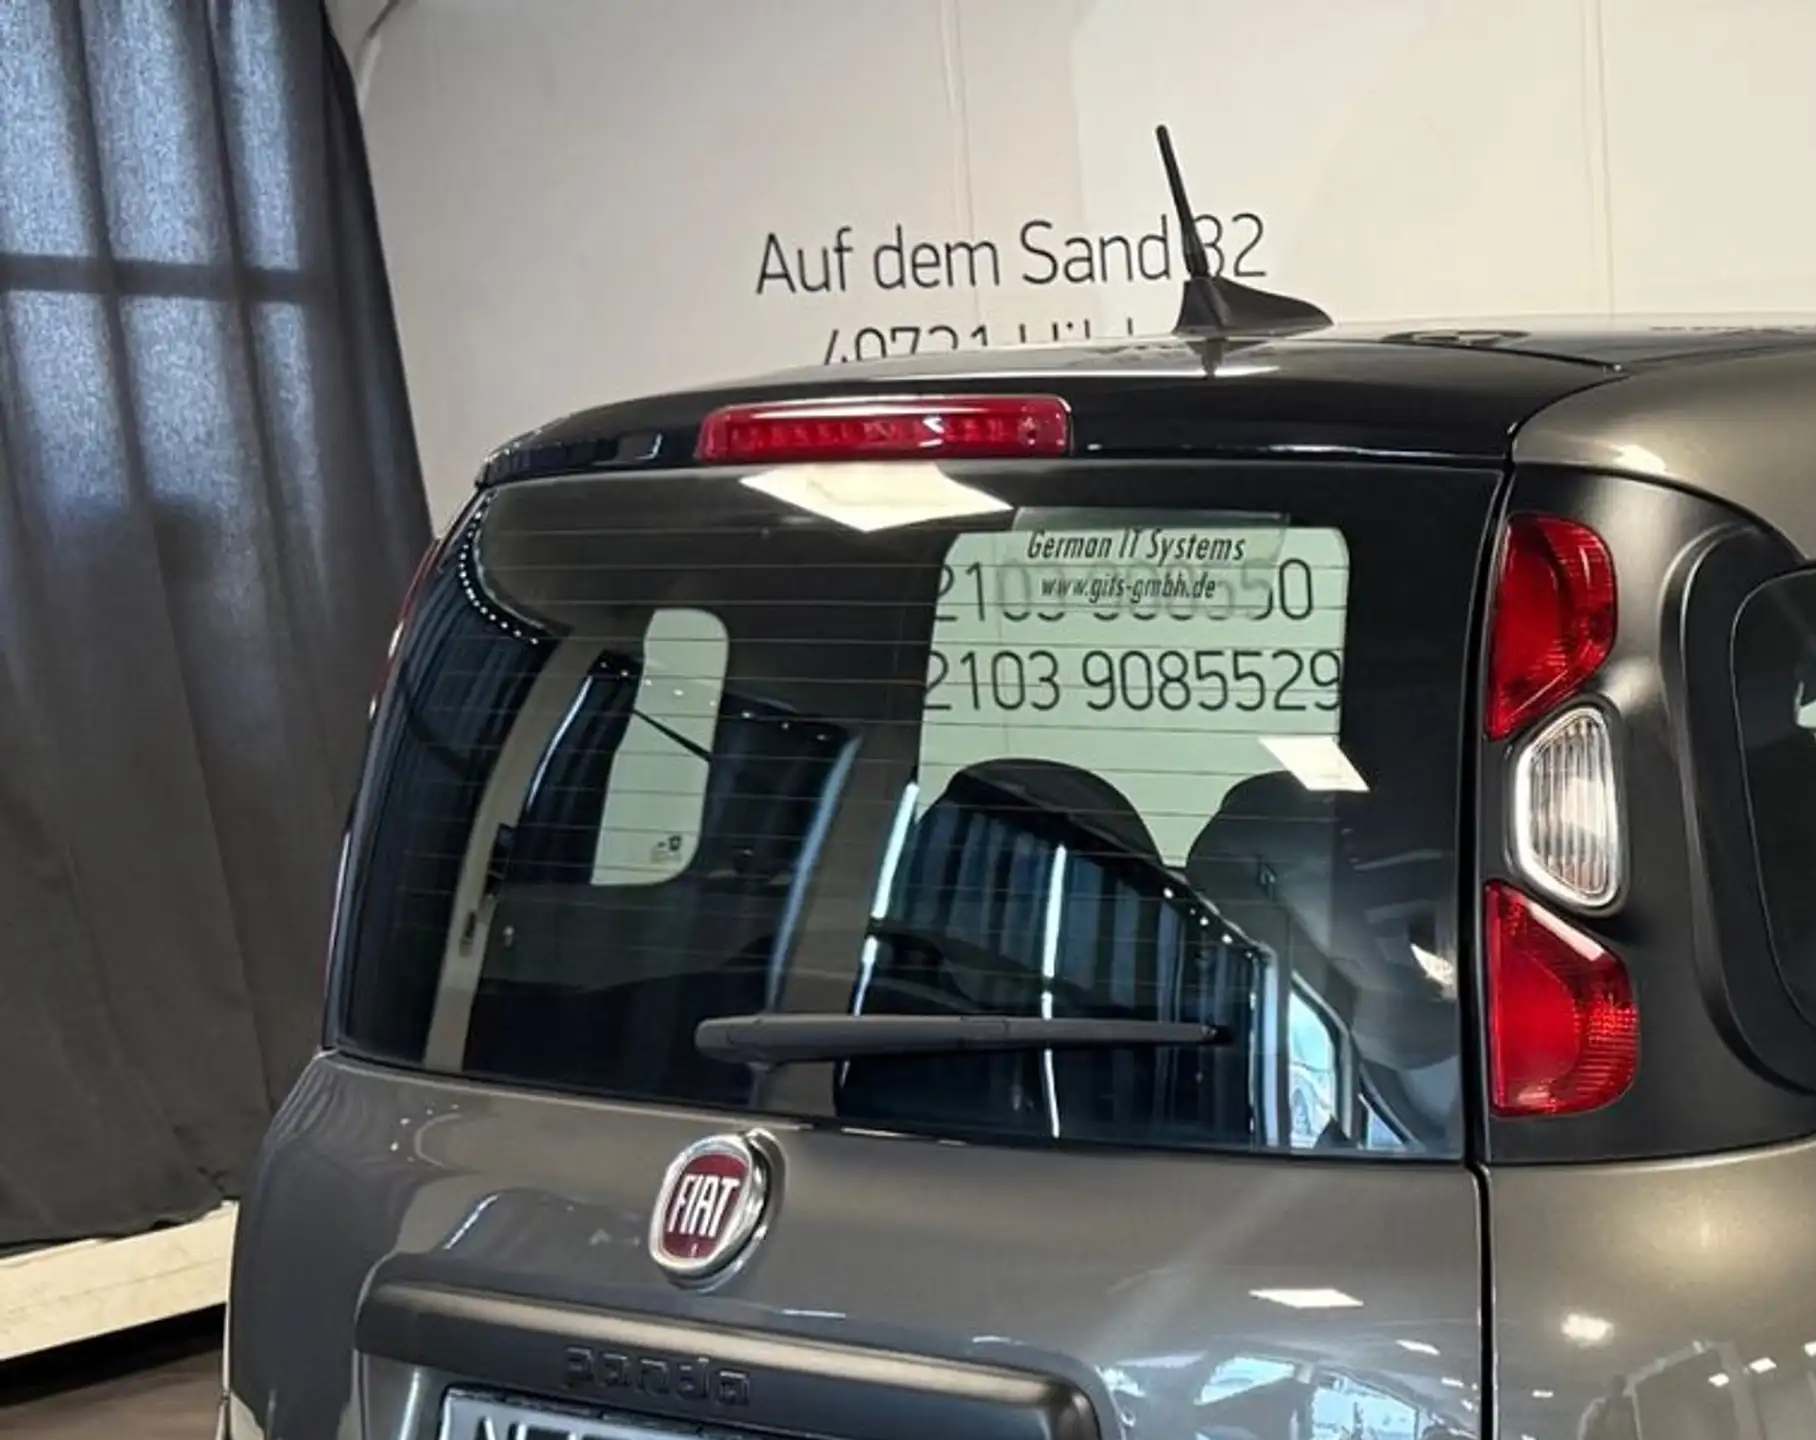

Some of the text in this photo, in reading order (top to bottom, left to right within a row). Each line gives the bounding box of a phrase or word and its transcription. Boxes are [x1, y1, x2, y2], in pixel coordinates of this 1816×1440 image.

[755, 226, 852, 295] Auf
[873, 224, 1001, 289] dem
[1020, 213, 1171, 287] Sand
[1027, 529, 1246, 567] German IT Systems
[1081, 649, 1341, 713] 9085529
[667, 1173, 741, 1239] FIAT
